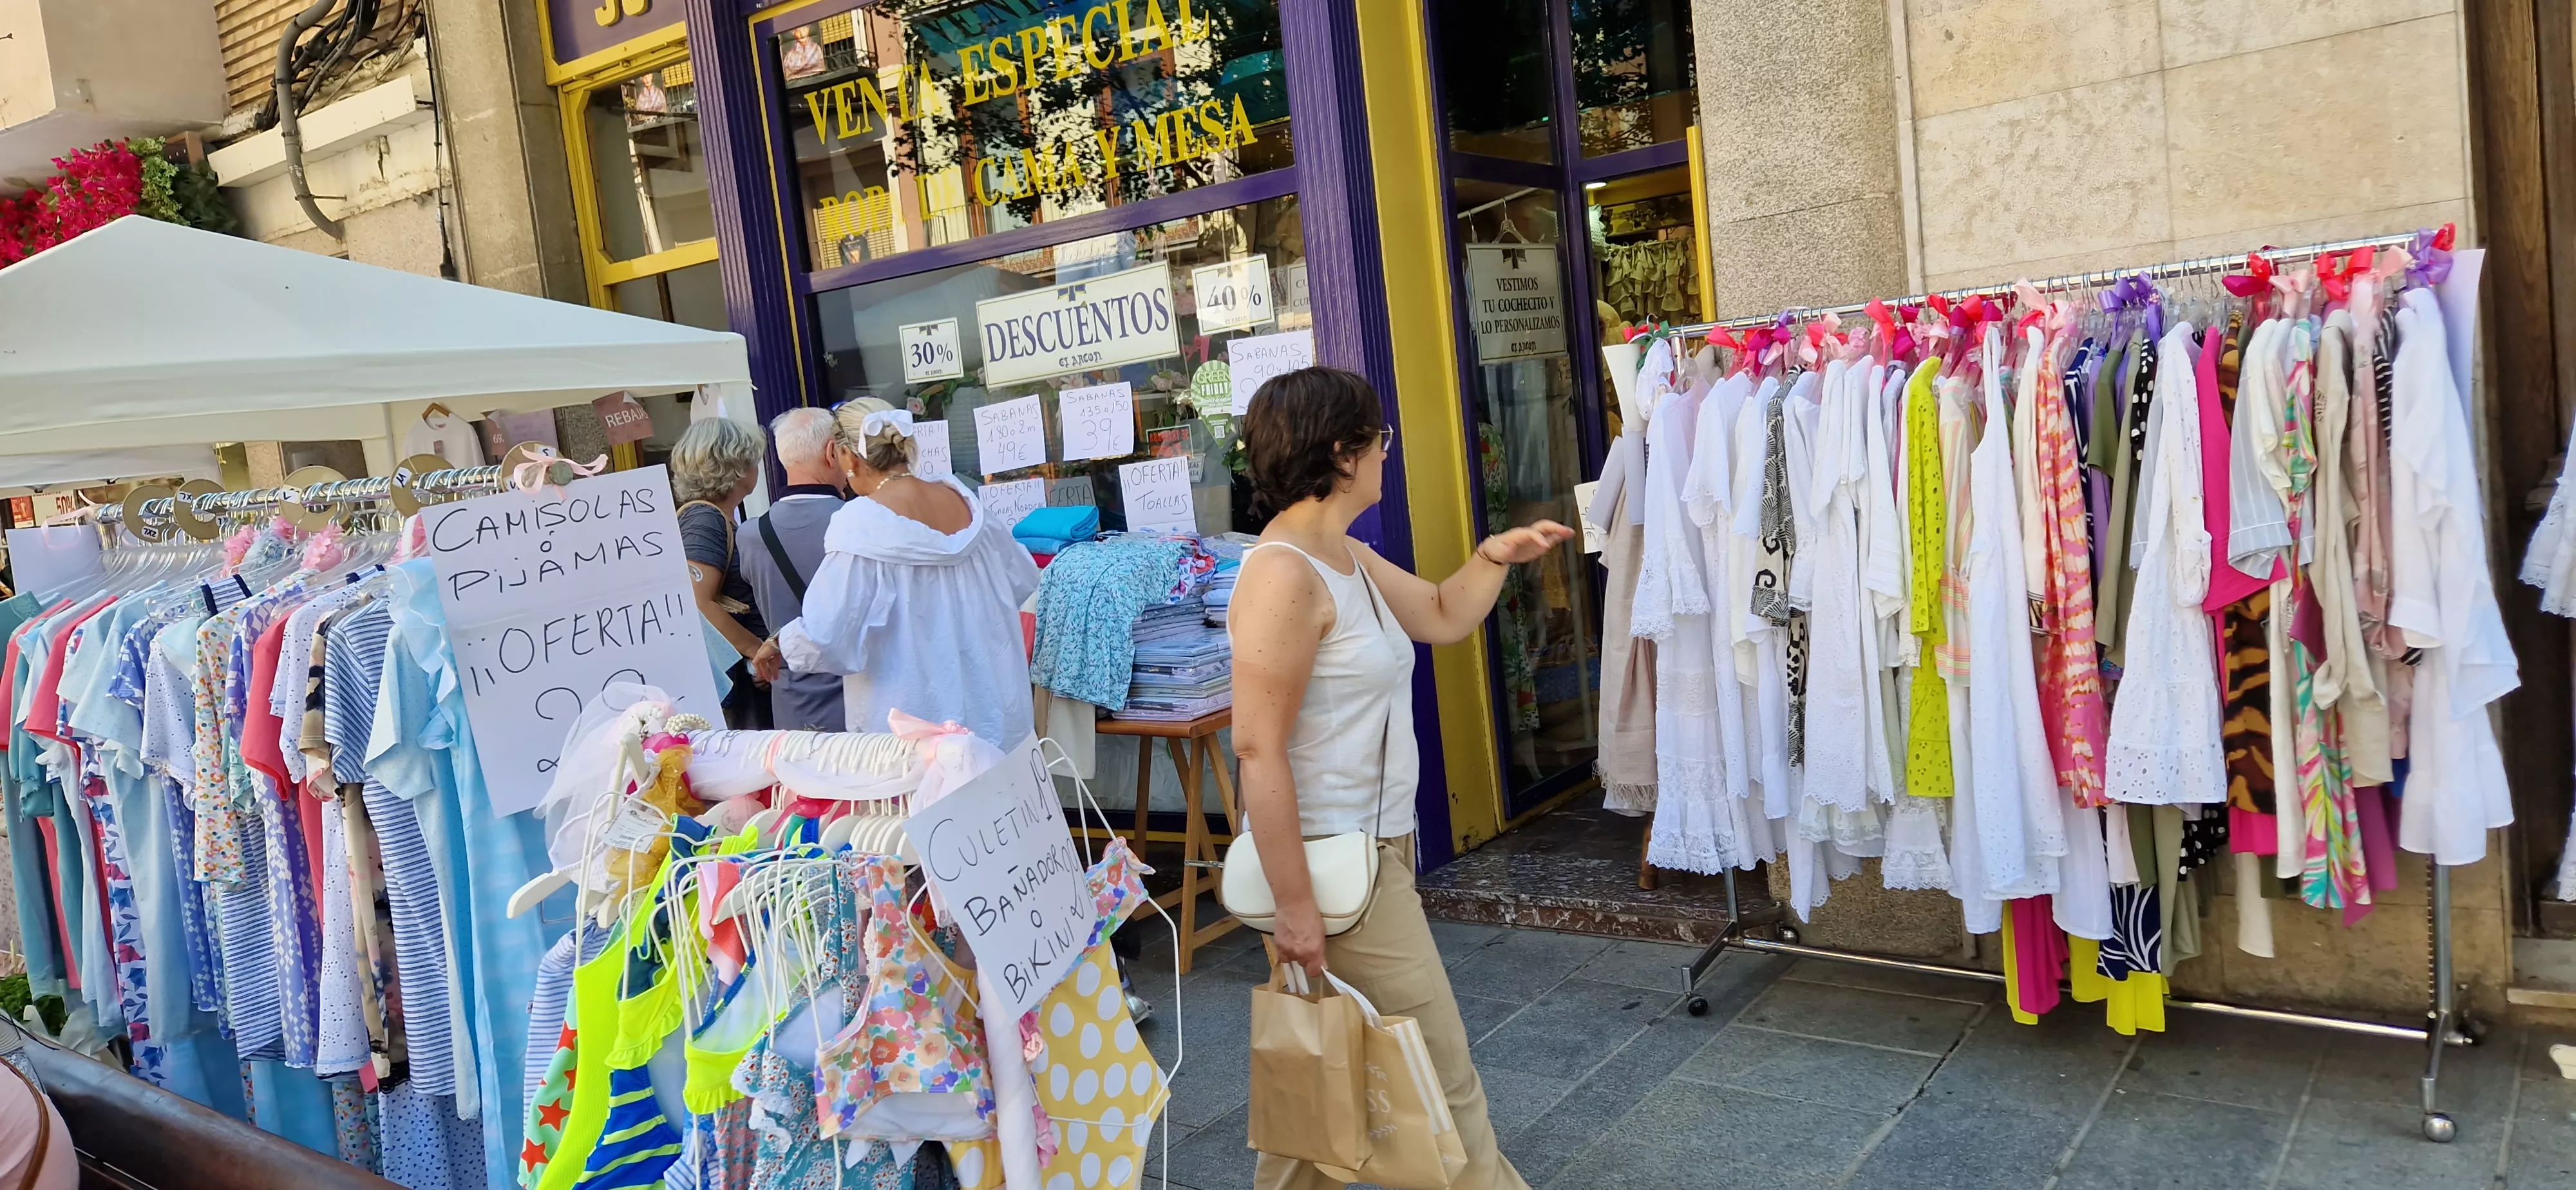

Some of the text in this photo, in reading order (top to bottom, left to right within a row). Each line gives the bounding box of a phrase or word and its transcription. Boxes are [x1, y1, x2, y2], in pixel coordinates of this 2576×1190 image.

[804, 0, 1210, 146] VENTA ESPECIAL
[974, 141, 1085, 207] CAMA
[1097, 126, 1121, 180] Y
[1131, 93, 1258, 172] MESA
[1496, 277, 1539, 292] VESTIMOS
[1207, 285, 1262, 312] 40%
[1482, 296, 1555, 313] TU COCHECITO Y
[985, 288, 1170, 363] DESCUENTOS
[1481, 316, 1560, 334] LO PERSONALIZAMOS
[911, 341, 953, 368] 30%
[1231, 342, 1302, 363] SABANAS
[1196, 369, 1231, 384] GREEN
[1064, 389, 1126, 404] SABANAS
[981, 402, 1039, 426] SABANAS
[1080, 405, 1101, 417] 135
[1135, 490, 1188, 515] TOALLAS
